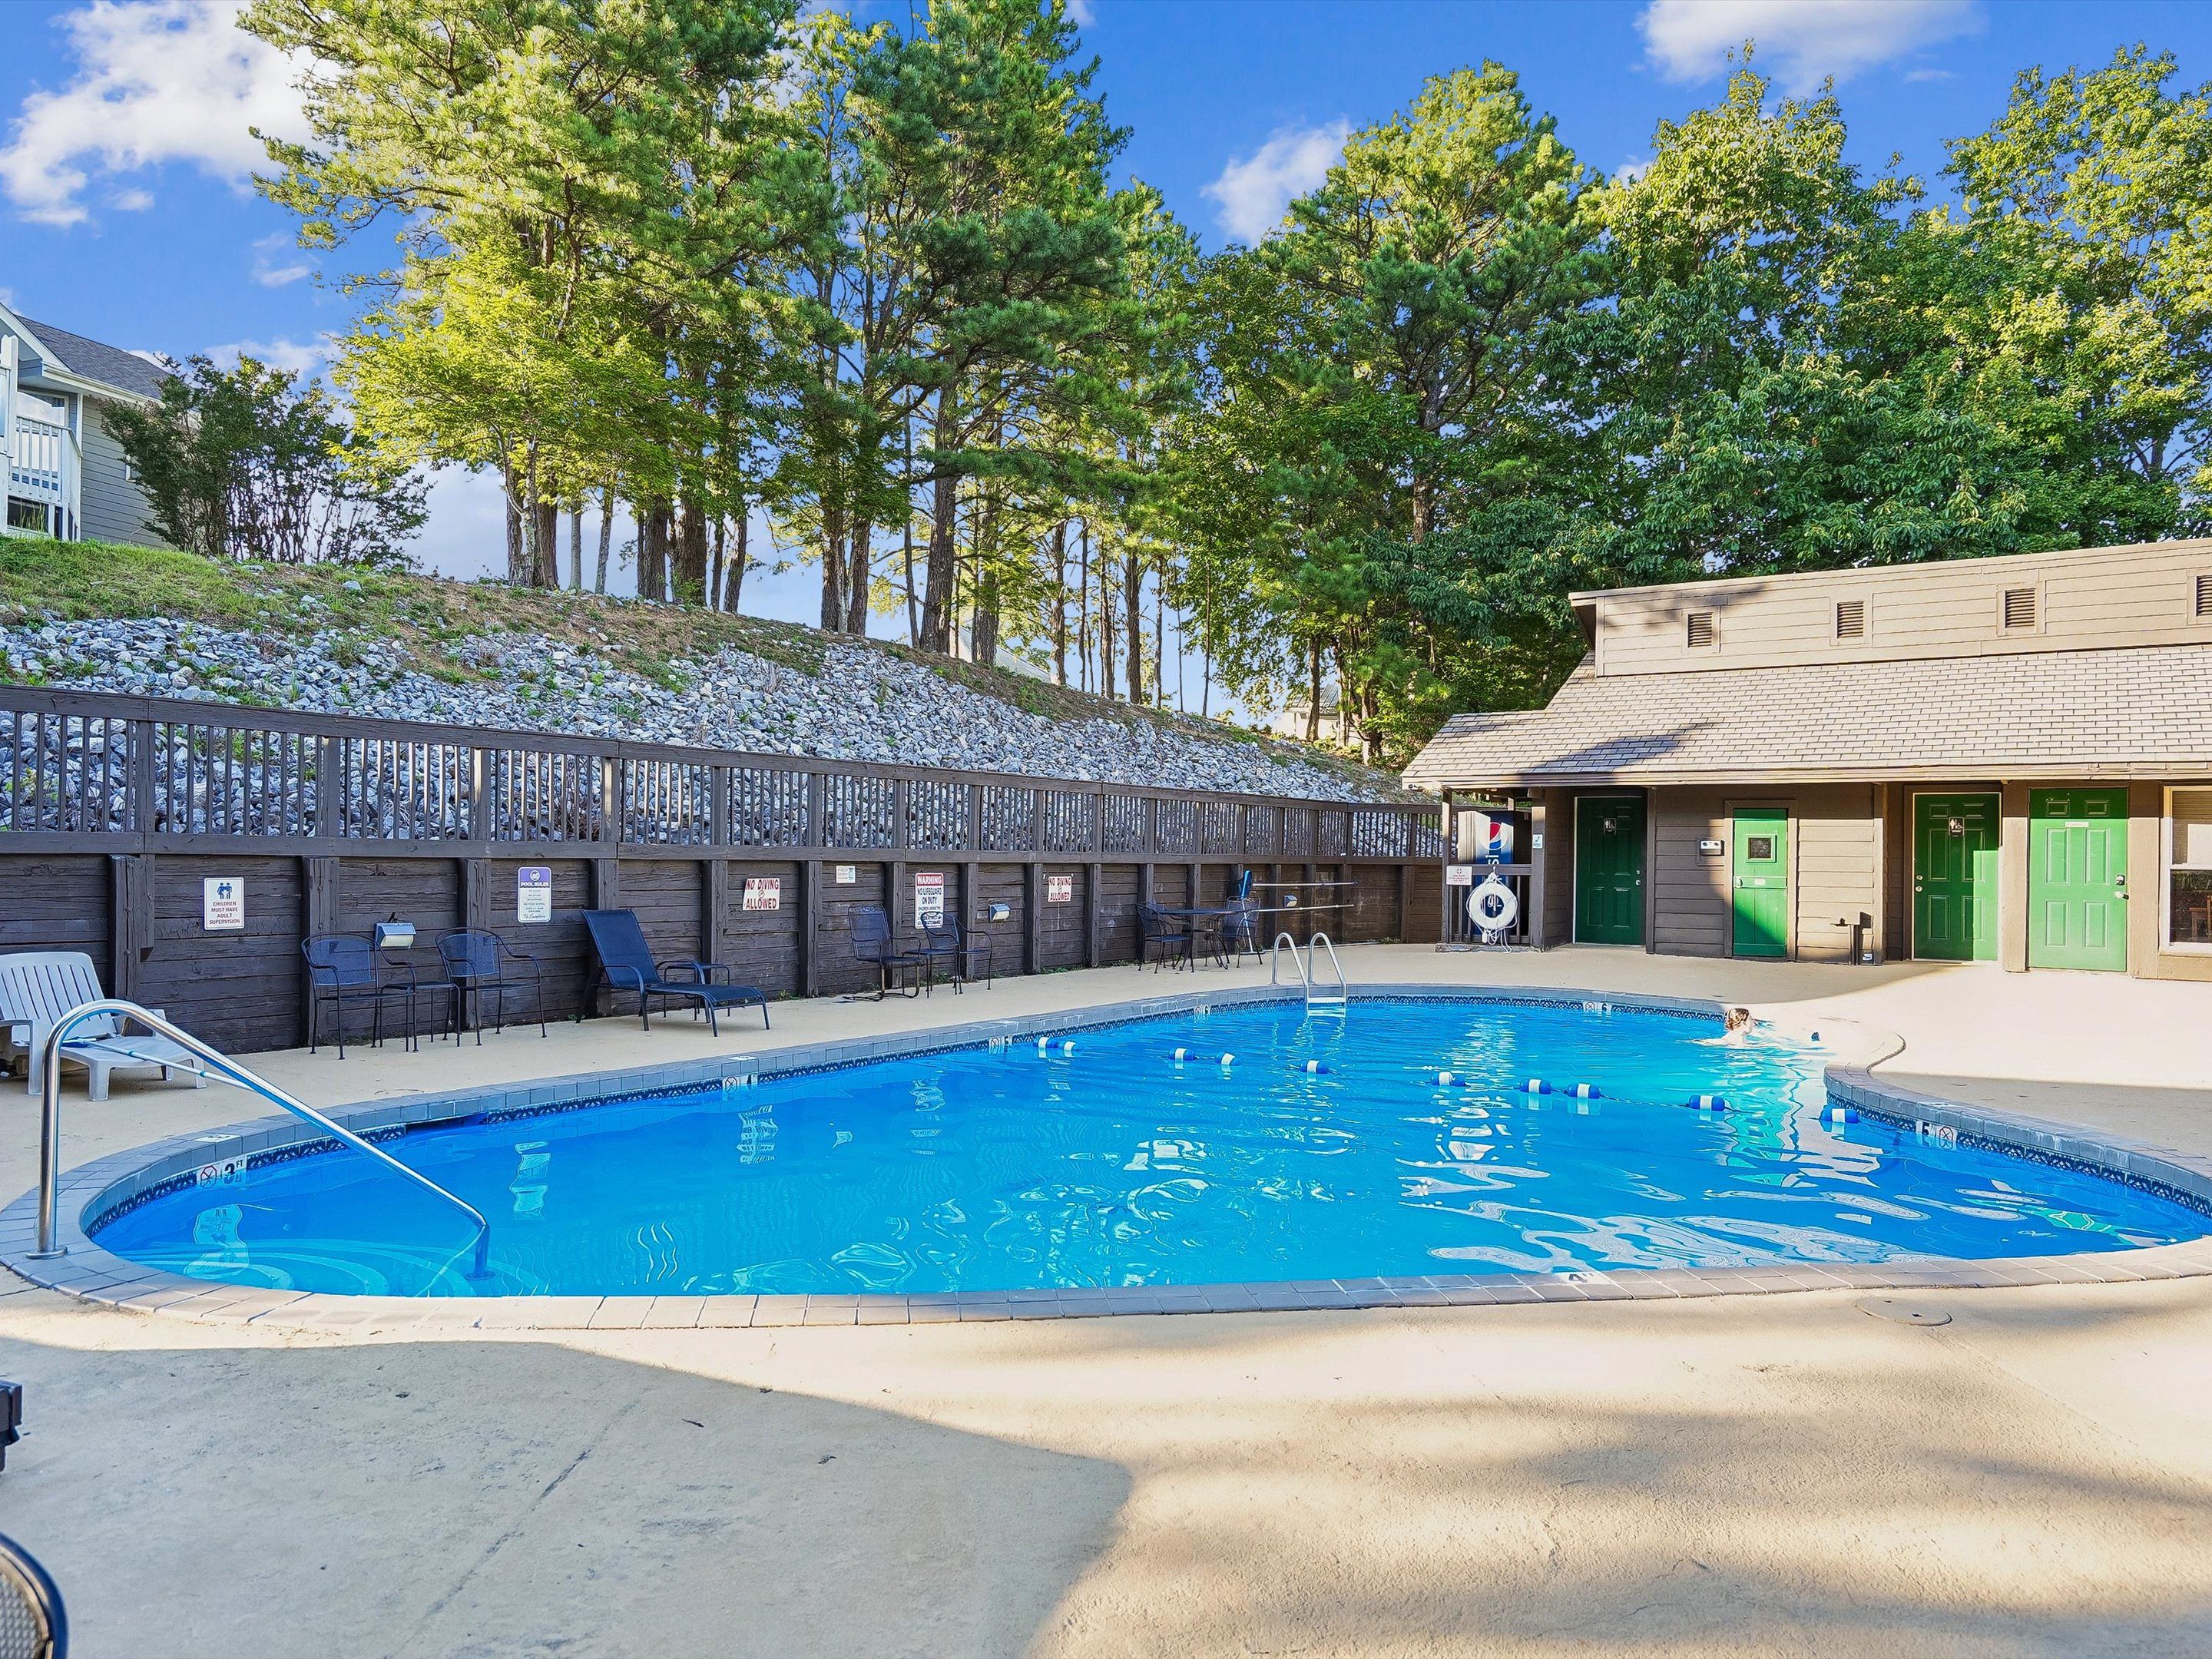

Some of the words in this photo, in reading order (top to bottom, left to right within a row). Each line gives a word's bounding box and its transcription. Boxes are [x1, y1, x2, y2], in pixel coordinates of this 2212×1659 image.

[746, 879, 755, 890] NO
[757, 879, 779, 890] DIVING
[917, 876, 942, 885] WARNING
[1049, 877, 1055, 886] NO
[1057, 877, 1071, 886] DIVING
[923, 887, 942, 896] LIFEGUARD
[1050, 892, 1070, 900] ALLOWED
[746, 898, 777, 909] ALLOWED
[1922, 1121, 1930, 1135] 5
[224, 1163, 235, 1176] 3
[236, 1159, 243, 1168] FT
